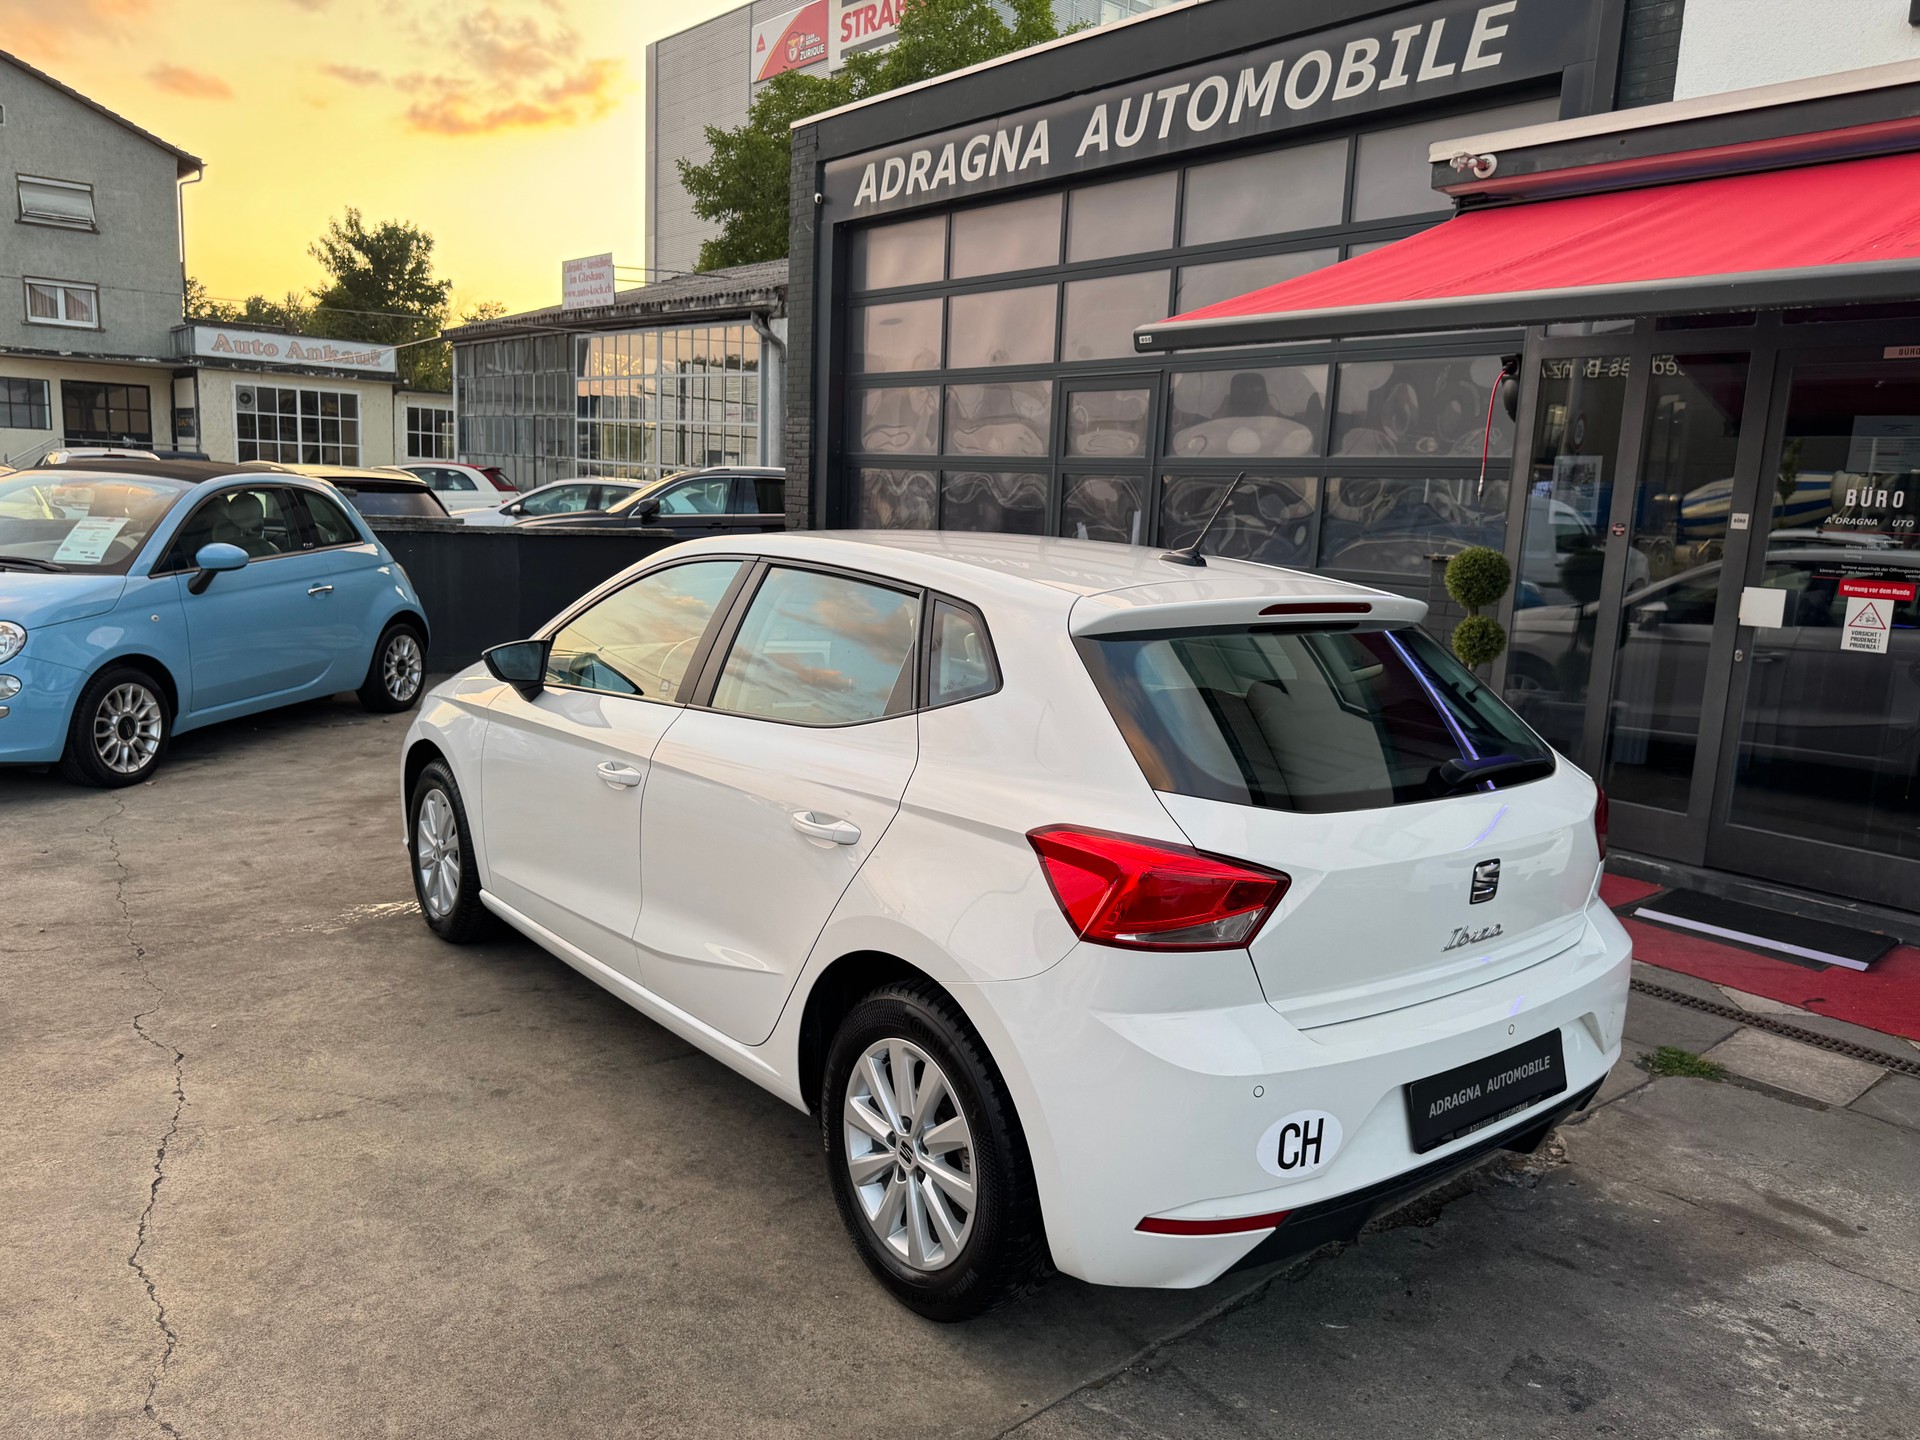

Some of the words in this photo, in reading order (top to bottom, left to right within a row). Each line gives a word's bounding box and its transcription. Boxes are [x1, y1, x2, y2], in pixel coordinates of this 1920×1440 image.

[799, 43, 825, 61] ZURIQUE
[854, 119, 1050, 207] ADRAGNA
[1075, 1, 1517, 157] AUTOMOBILE
[211, 333, 279, 357] Auto
[285, 341, 381, 367] Ankauf
[1845, 486, 1905, 508] BÜRO
[1843, 585, 1868, 594] Warnung
[1891, 588, 1911, 596] Hunde
[1850, 636, 1877, 644] PRUDENCE
[1851, 630, 1878, 638] VORSICHT
[1849, 642, 1876, 650] PRUDENZA
[1441, 924, 1504, 952] Ibiza
[1428, 1083, 1481, 1119] ADRAGNA
[1486, 1055, 1551, 1094] AUTOMOBILE
[1277, 1117, 1325, 1170] CH
